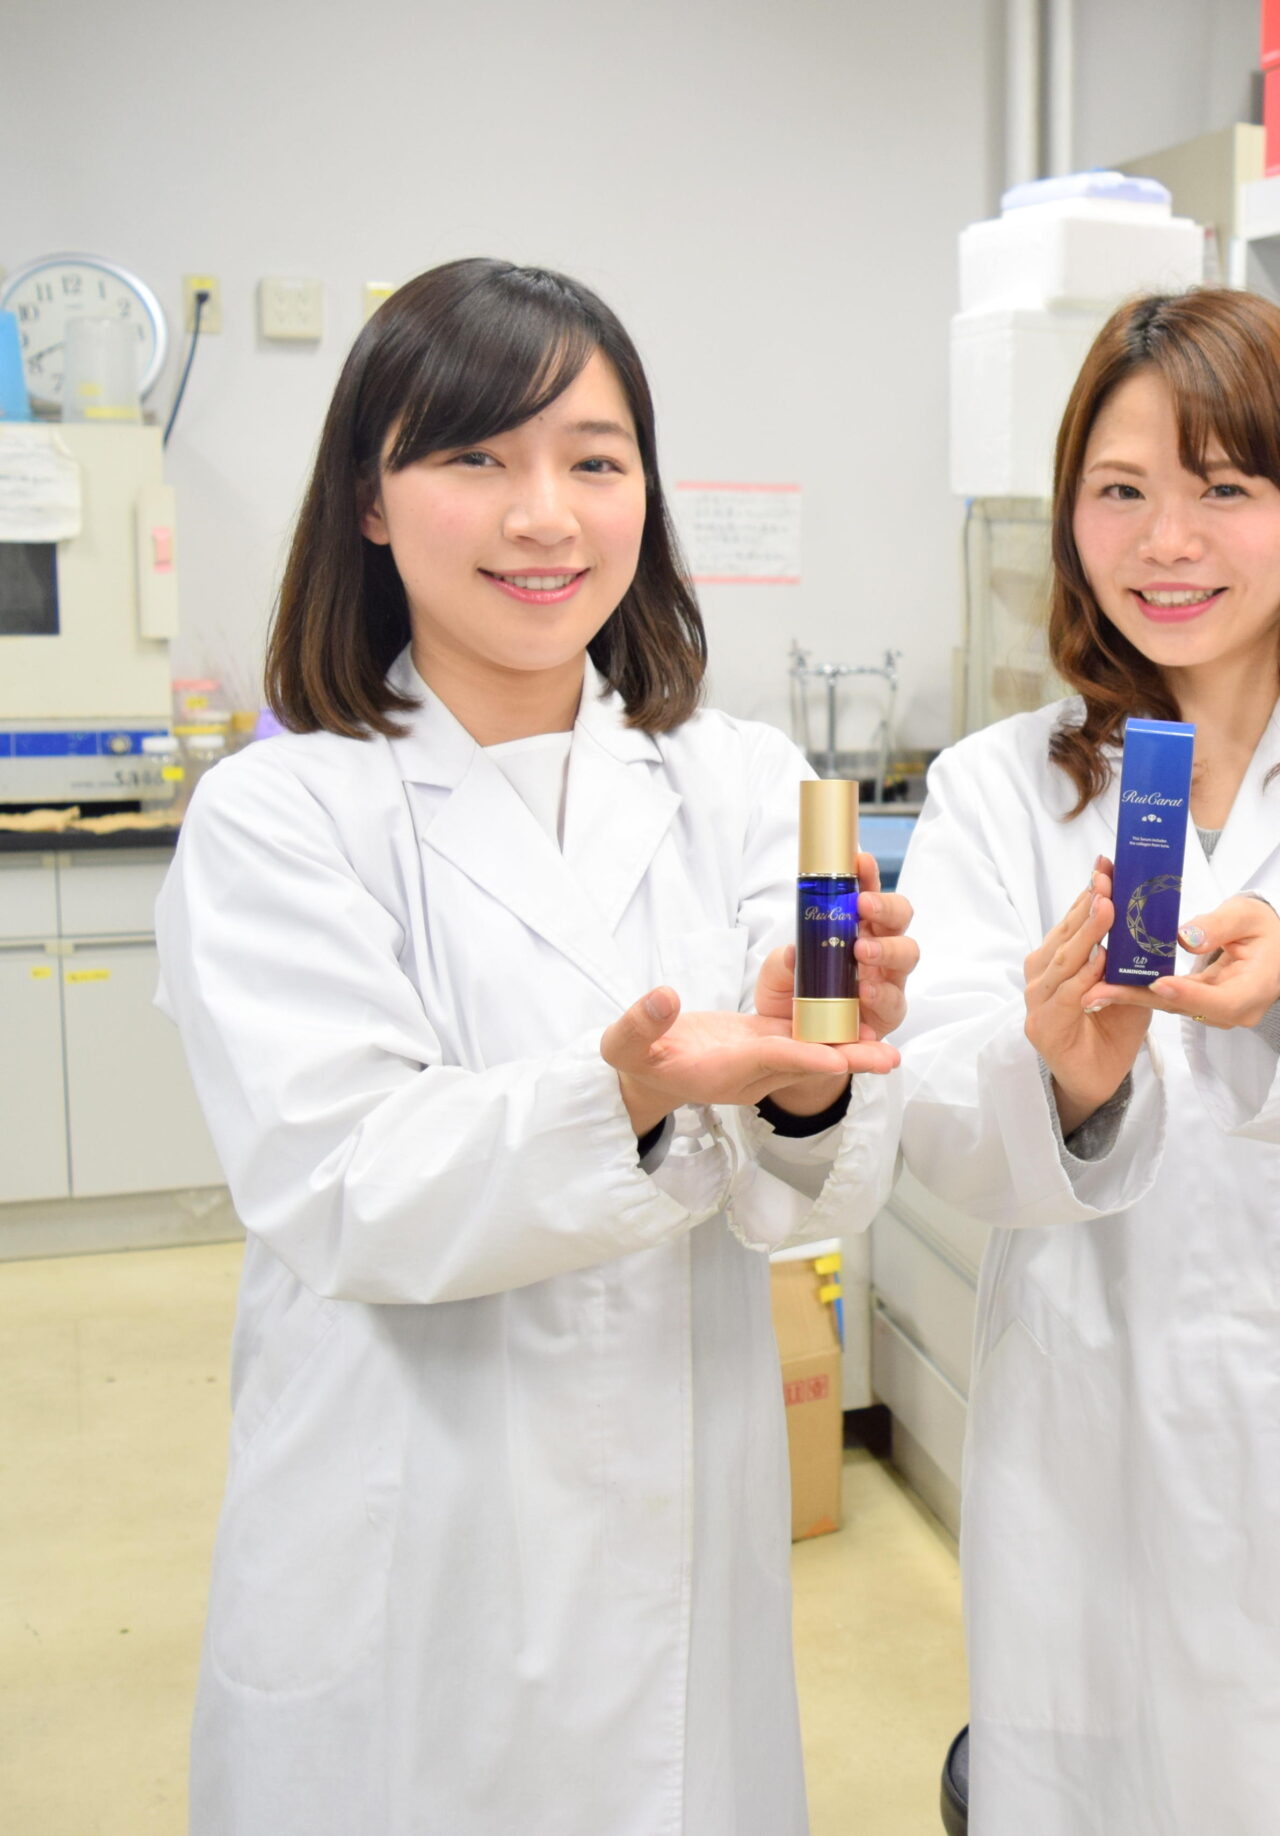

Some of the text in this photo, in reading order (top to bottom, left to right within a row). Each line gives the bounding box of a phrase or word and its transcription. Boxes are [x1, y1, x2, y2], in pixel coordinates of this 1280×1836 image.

[36, 282, 53, 301] 11
[61, 273, 82, 294] 12
[97, 279, 106, 299] 1
[18, 302, 40, 321] 10
[118, 298, 130, 318] 2
